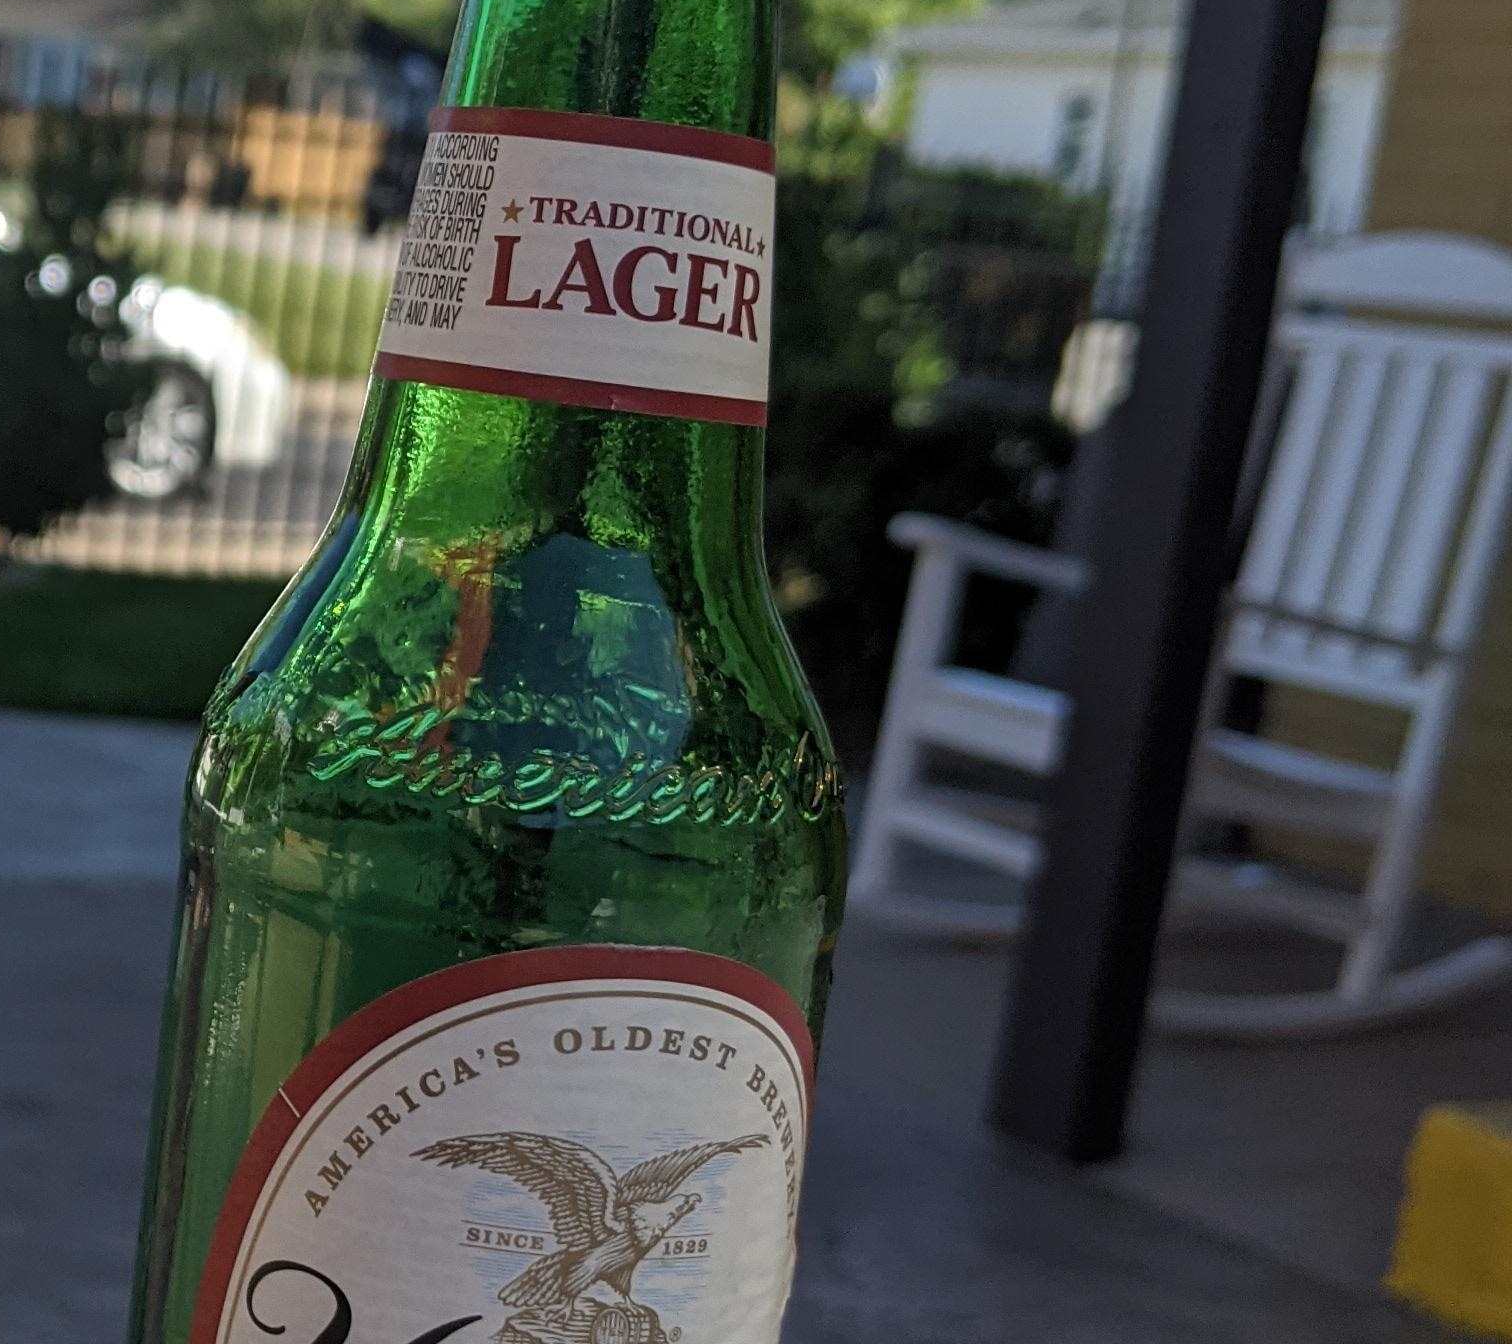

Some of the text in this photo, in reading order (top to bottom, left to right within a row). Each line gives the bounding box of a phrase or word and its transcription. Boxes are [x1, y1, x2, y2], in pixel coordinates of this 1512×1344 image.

[448, 163, 495, 191] SHOULD
[440, 190, 487, 218] DURING
[429, 216, 445, 240] OF
[443, 217, 482, 245] BIRTH
[530, 197, 755, 254] TRADITIONAL
[409, 242, 474, 273] ALCOHOLIC
[428, 274, 467, 302] DRIVE
[485, 235, 759, 343] LAGER
[403, 299, 429, 327] AND
[430, 302, 462, 330] MAY
[303, 1039, 522, 1218] AMERICA'S
[552, 1026, 737, 1071] OLDEST
[466, 1227, 708, 1256] SINCE 1829
